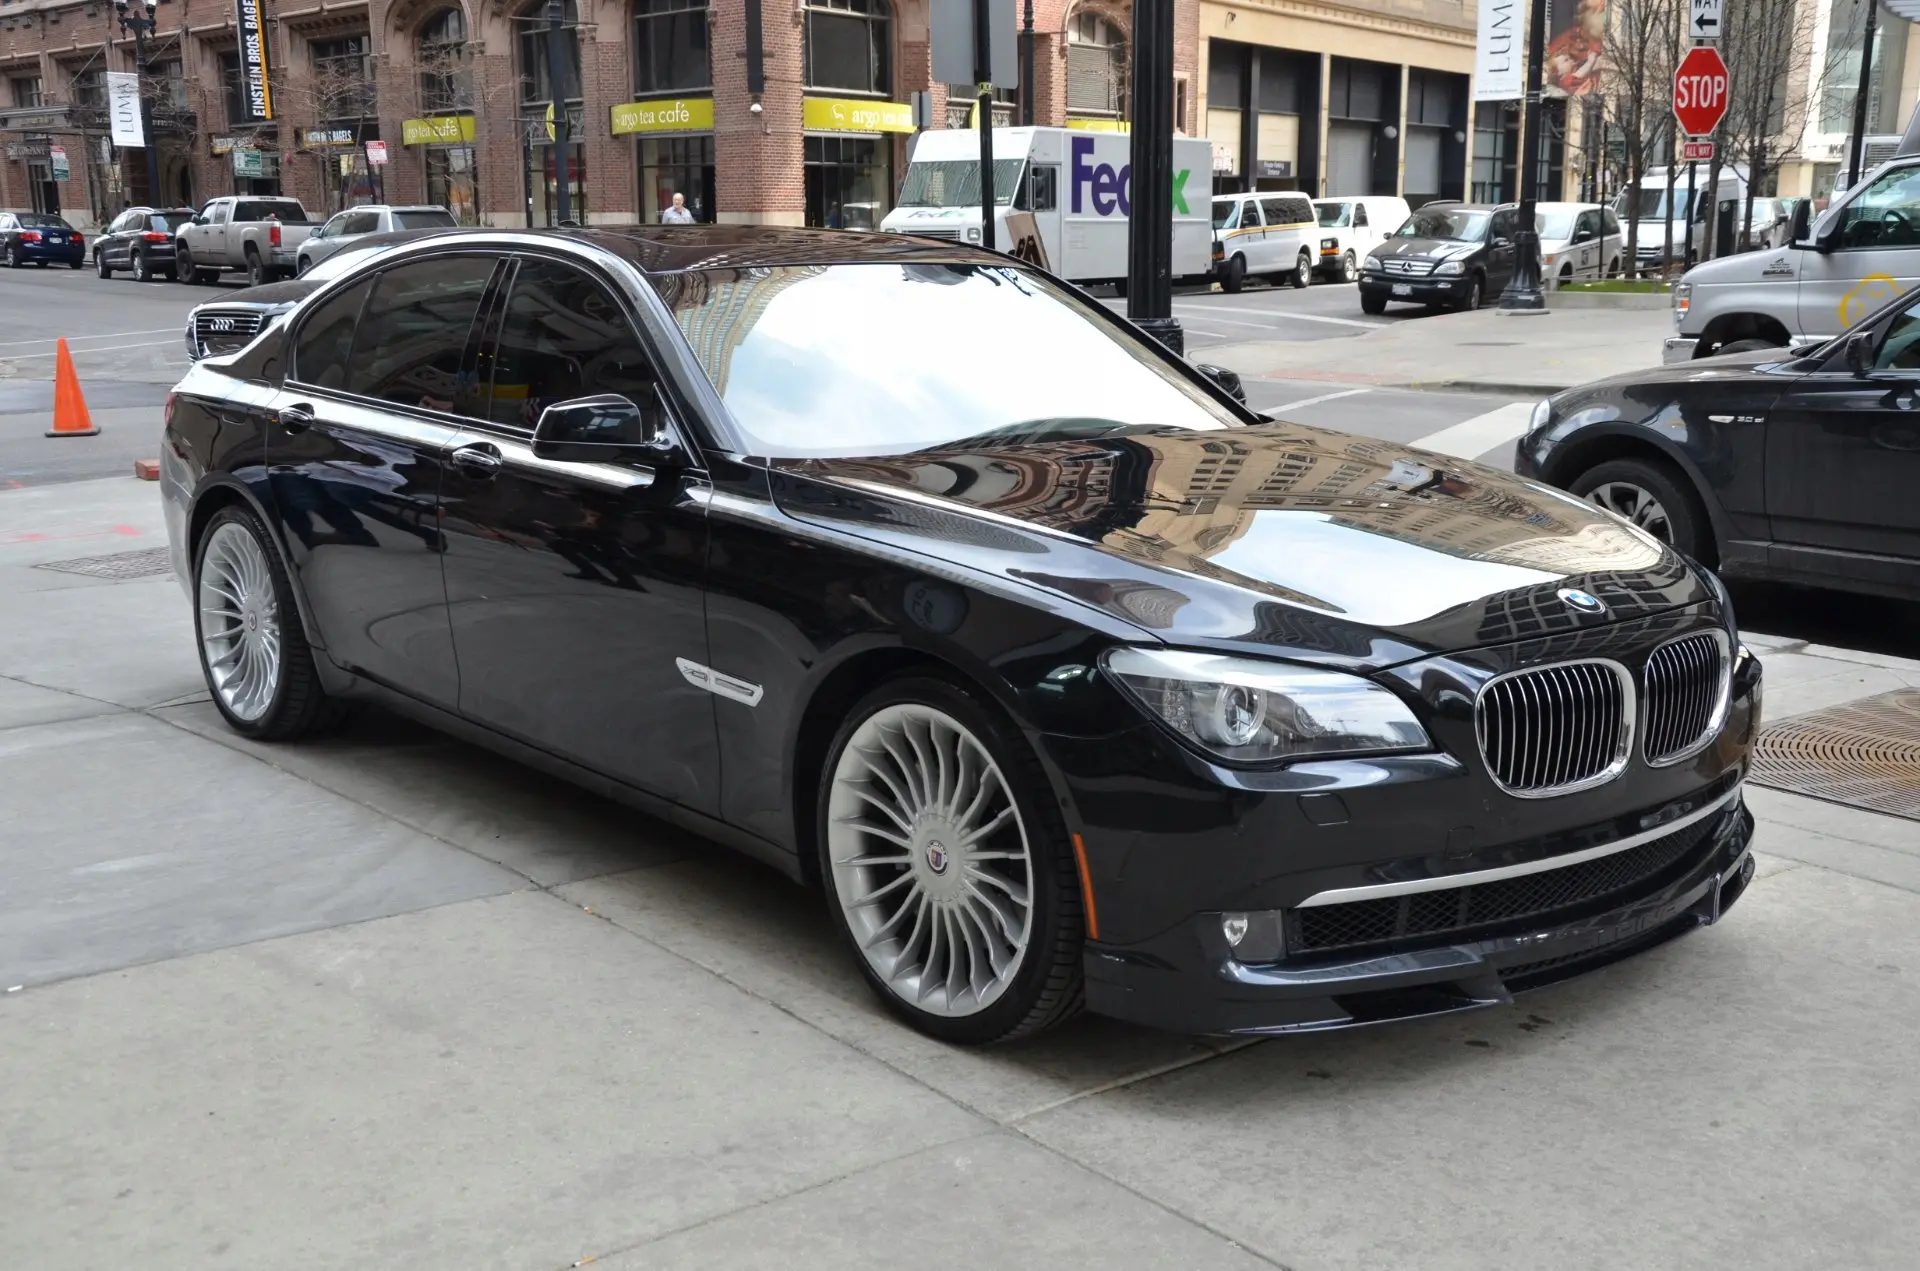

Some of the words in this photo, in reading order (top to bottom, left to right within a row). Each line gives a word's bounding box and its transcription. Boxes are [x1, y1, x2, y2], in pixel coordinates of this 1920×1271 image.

[246, 33, 261, 63] BROS.
[249, 66, 266, 117] EINSTEIN
[1677, 75, 1725, 108] STOP
[117, 83, 134, 133] LUMA
[620, 112, 638, 130] argo
[639, 109, 655, 125] tea
[658, 101, 690, 123] café
[852, 109, 880, 129] argo
[332, 129, 352, 142] BAGELS
[432, 118, 458, 137] café
[1685, 144, 1697, 157] ALL
[1698, 144, 1711, 157] WAY
[1071, 136, 1191, 216] Fex
